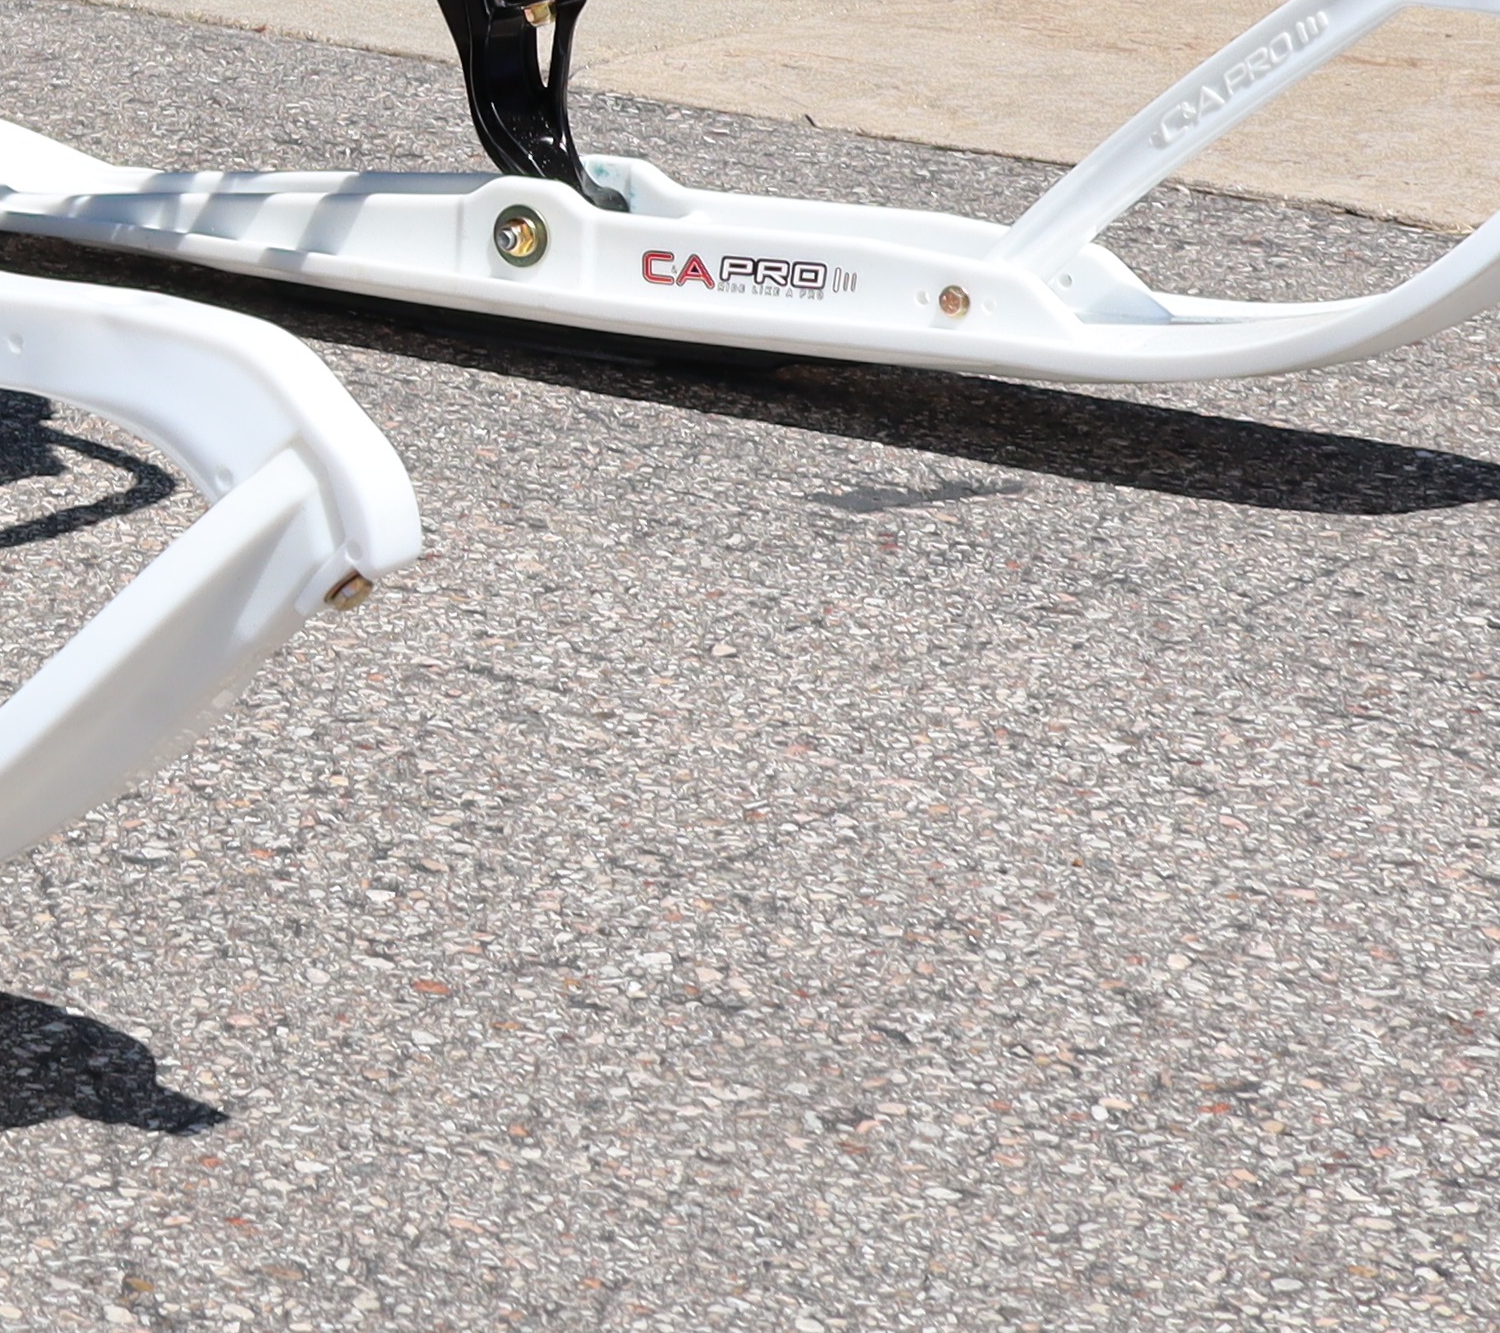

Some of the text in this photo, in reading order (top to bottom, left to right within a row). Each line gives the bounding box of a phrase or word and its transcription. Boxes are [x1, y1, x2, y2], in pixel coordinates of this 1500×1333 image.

[719, 255, 828, 290] PRO
[752, 284, 781, 298] LIKE
[785, 287, 794, 298] A
[799, 288, 825, 301] PRO
